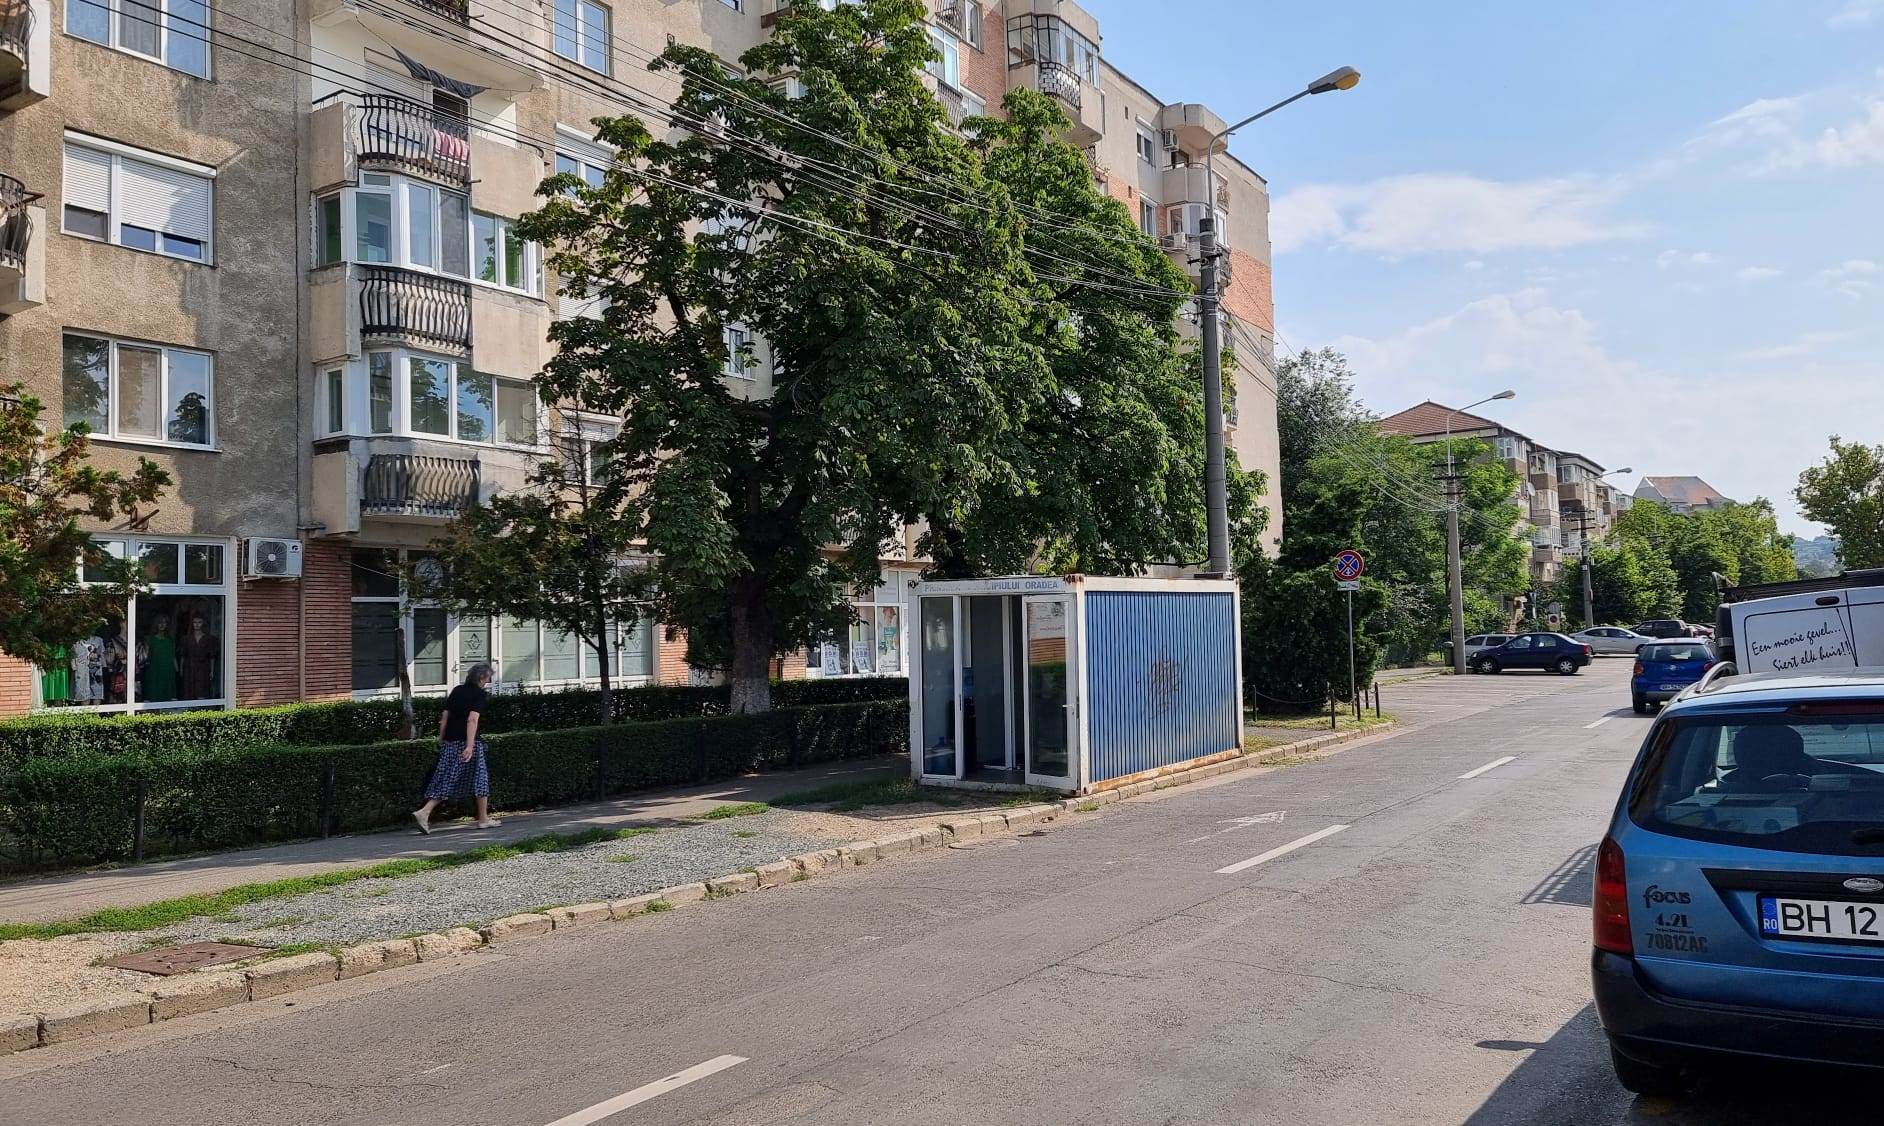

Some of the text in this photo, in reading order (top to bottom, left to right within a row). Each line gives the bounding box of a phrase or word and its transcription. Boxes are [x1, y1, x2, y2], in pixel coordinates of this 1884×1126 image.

[1025, 580, 1058, 590] ORADEA
[1752, 641, 1771, 656] Een
[1774, 632, 1805, 649] mooie
[1773, 655, 1800, 671] Siert
[1800, 650, 1818, 665] elk
[1763, 917, 1778, 930] RO
[1780, 902, 1879, 936] BH 12
